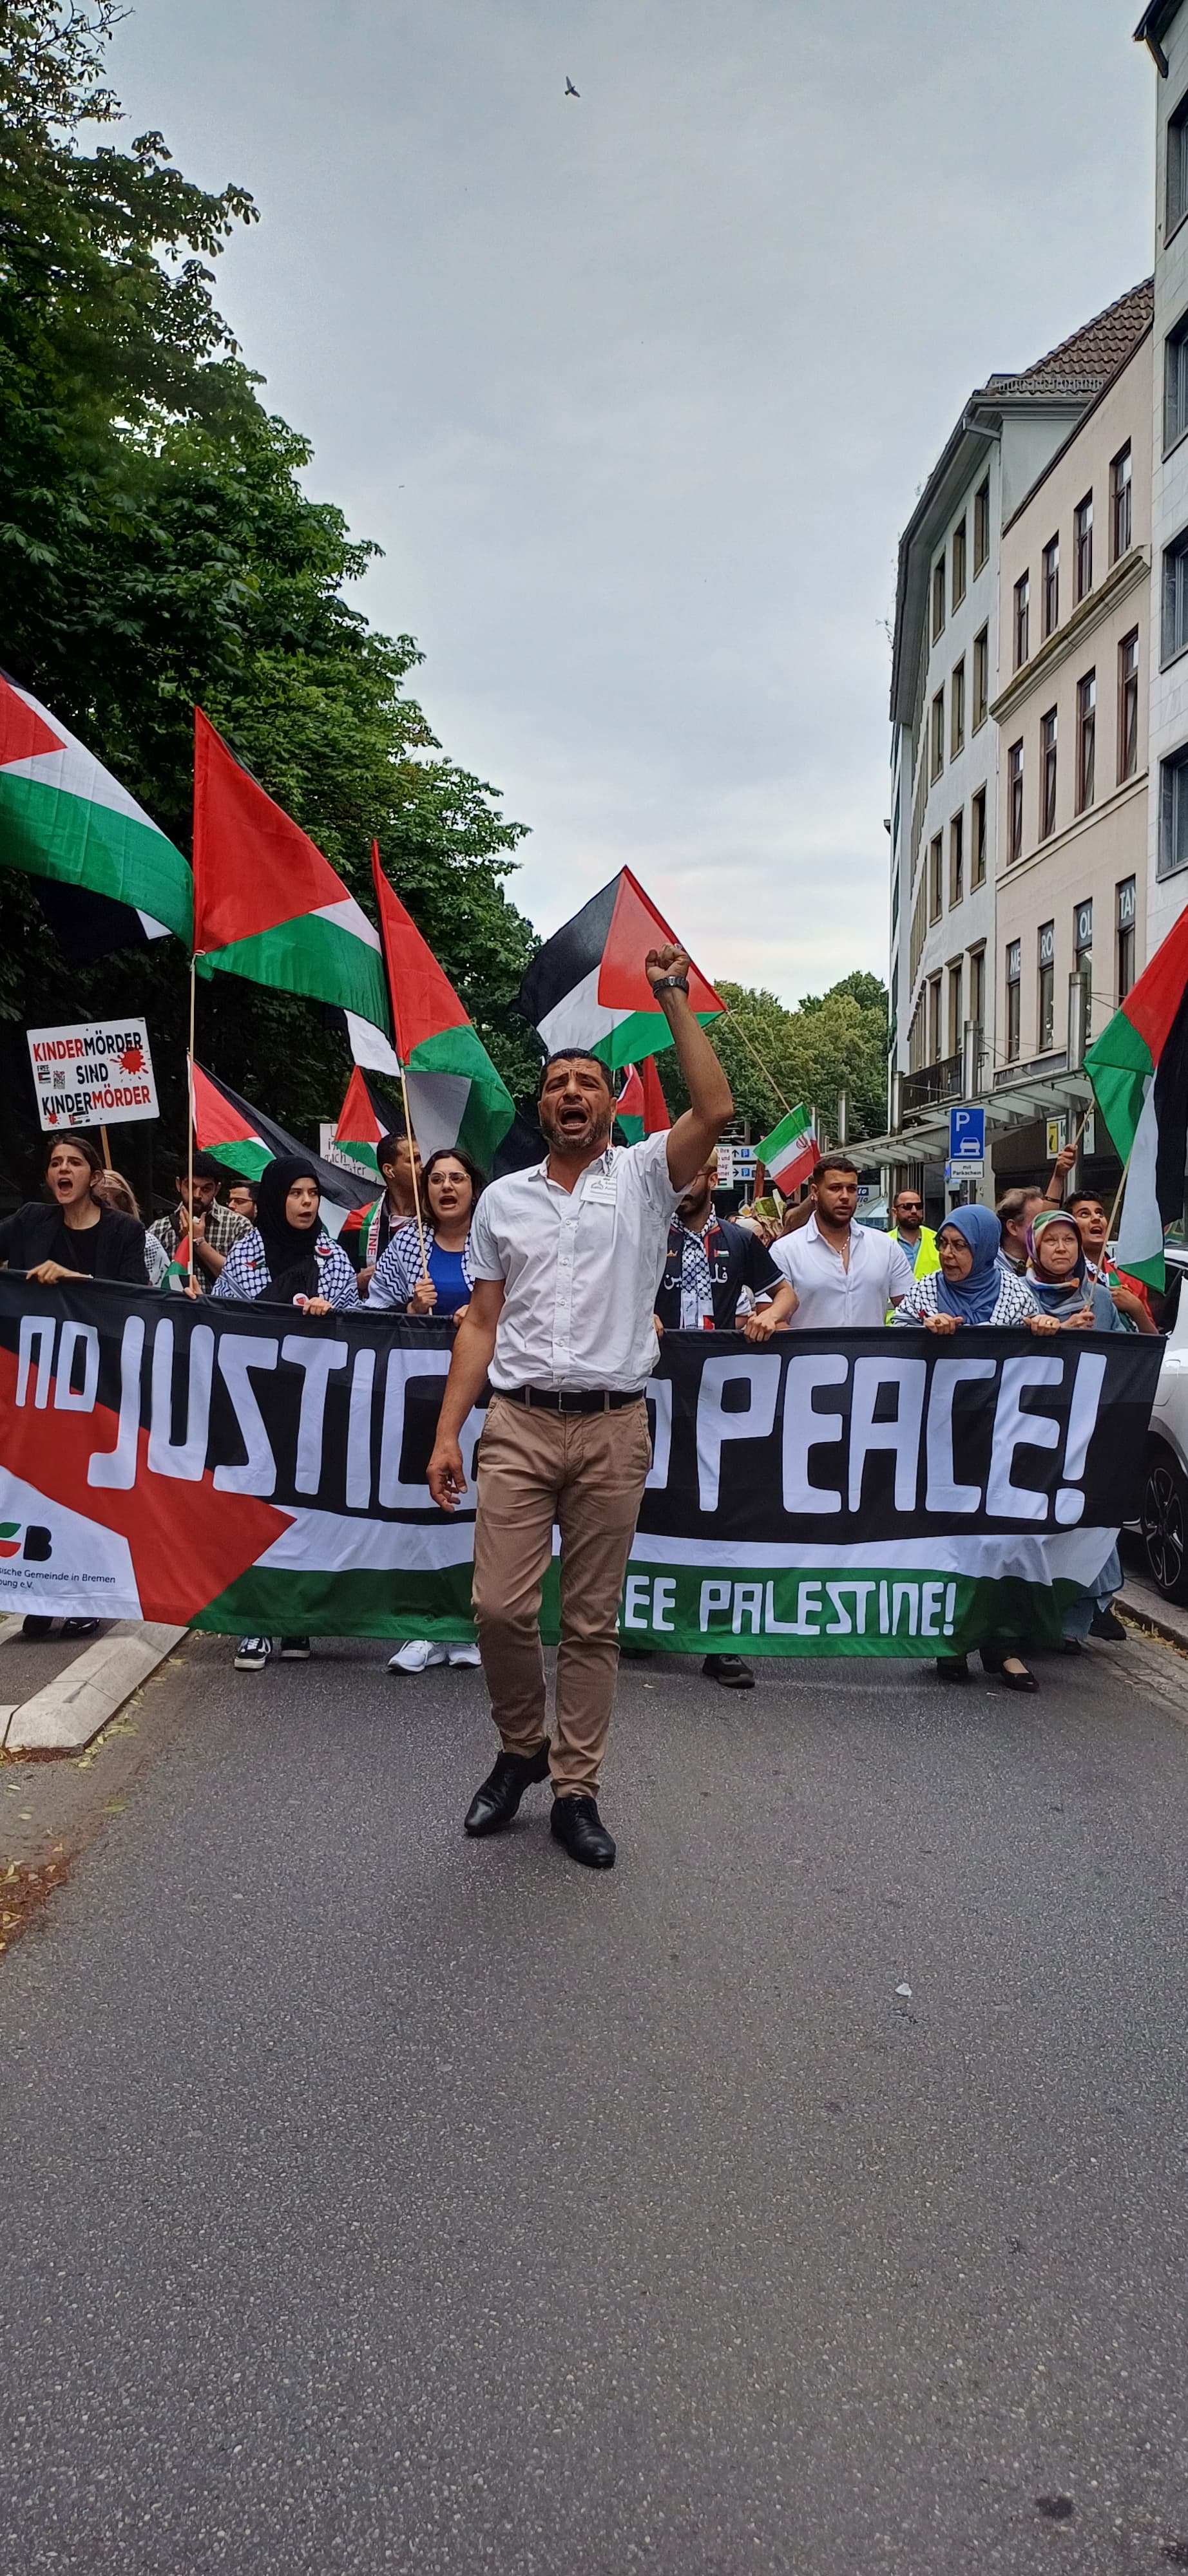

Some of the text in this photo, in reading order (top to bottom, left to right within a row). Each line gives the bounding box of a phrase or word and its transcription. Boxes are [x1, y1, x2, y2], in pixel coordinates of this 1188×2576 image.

[33, 1030, 142, 1062] KINDERMÖRDER
[76, 1063, 108, 1084] SIND
[42, 1083, 151, 1115] KINDERMÖRDER
[956, 1112, 970, 1132] P
[696, 1351, 1107, 1525] PEACE!
[24, 1569, 69, 1580] Gemeinde
[82, 1574, 115, 1583] Bremen
[699, 1580, 957, 1636] PALESTINE!
